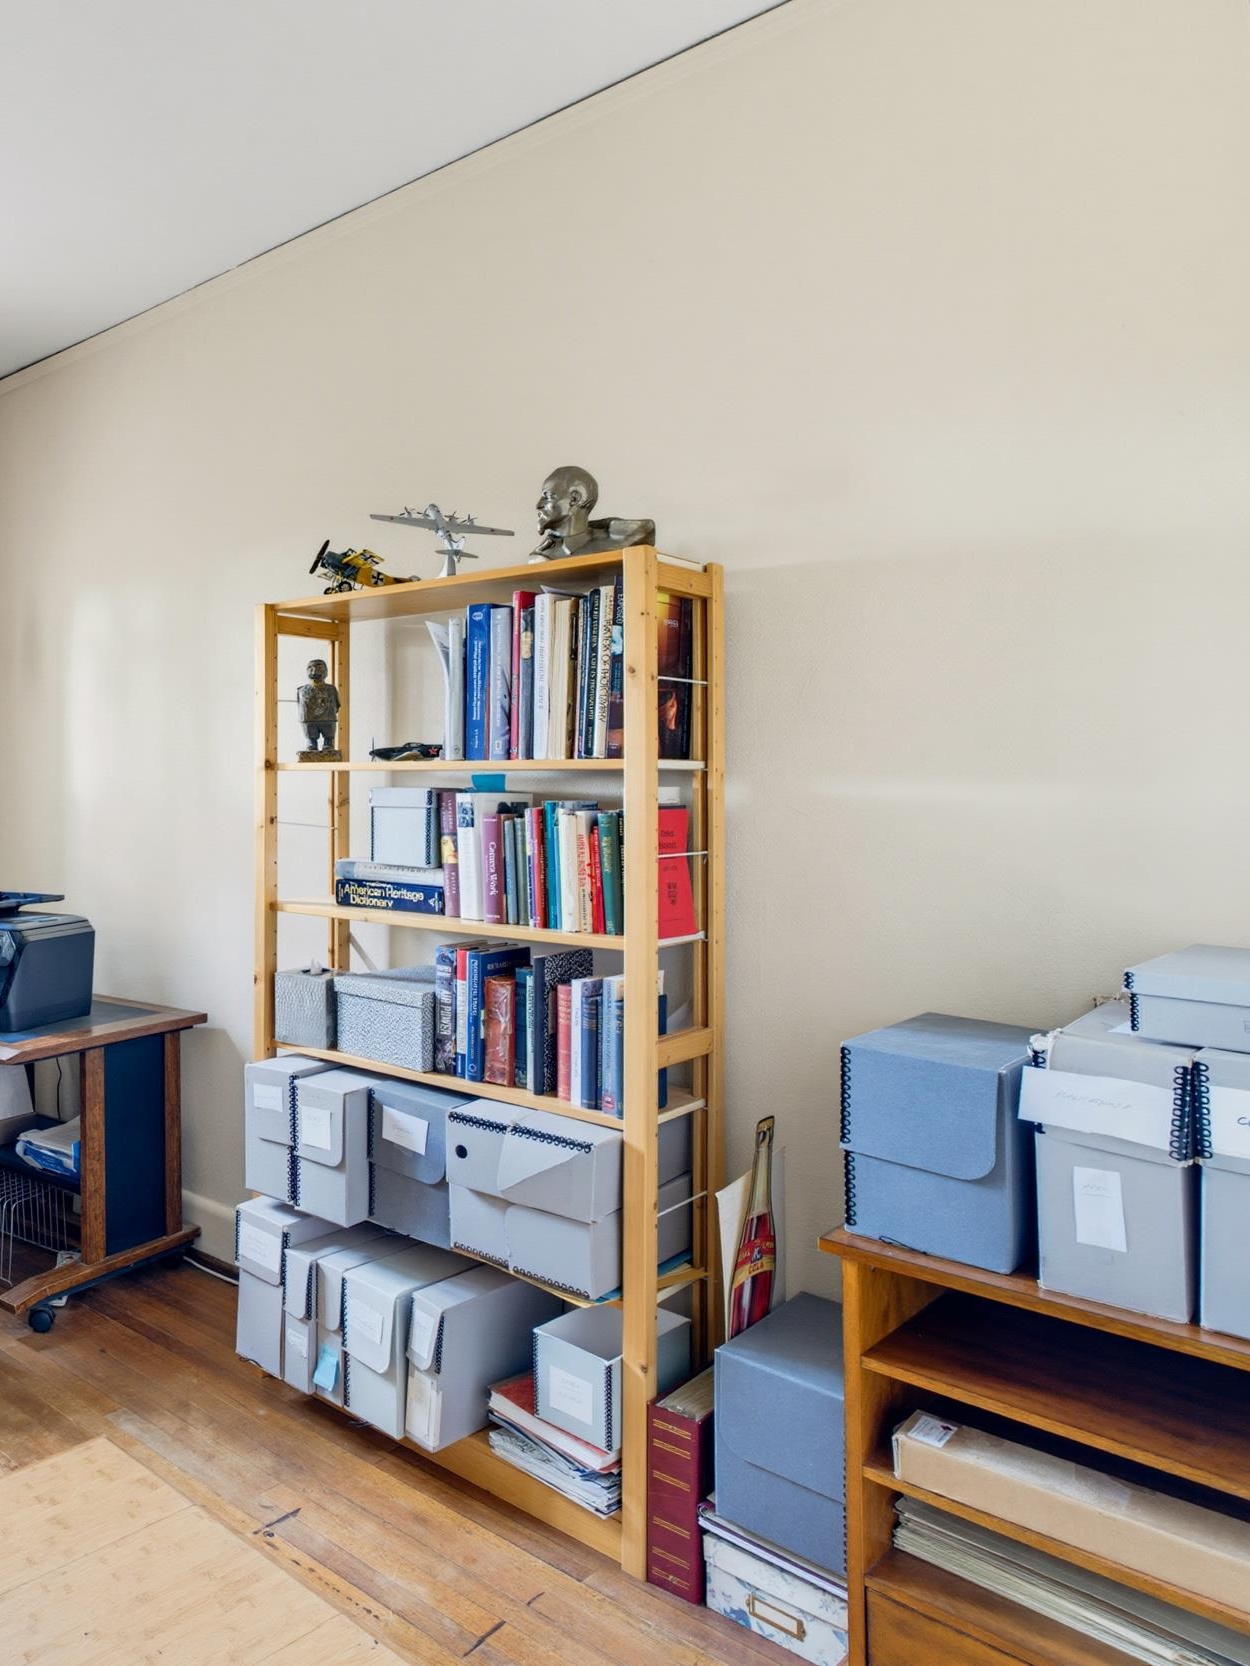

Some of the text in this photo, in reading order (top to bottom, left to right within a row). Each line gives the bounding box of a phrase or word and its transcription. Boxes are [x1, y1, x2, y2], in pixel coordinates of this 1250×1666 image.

[488, 841, 499, 896] Camera Work
[344, 882, 385, 898] American
[386, 886, 424, 903] Heritage
[350, 894, 394, 908] Dictionary
[439, 1005, 453, 1036] POWER
[748, 1261, 765, 1275] COLA
